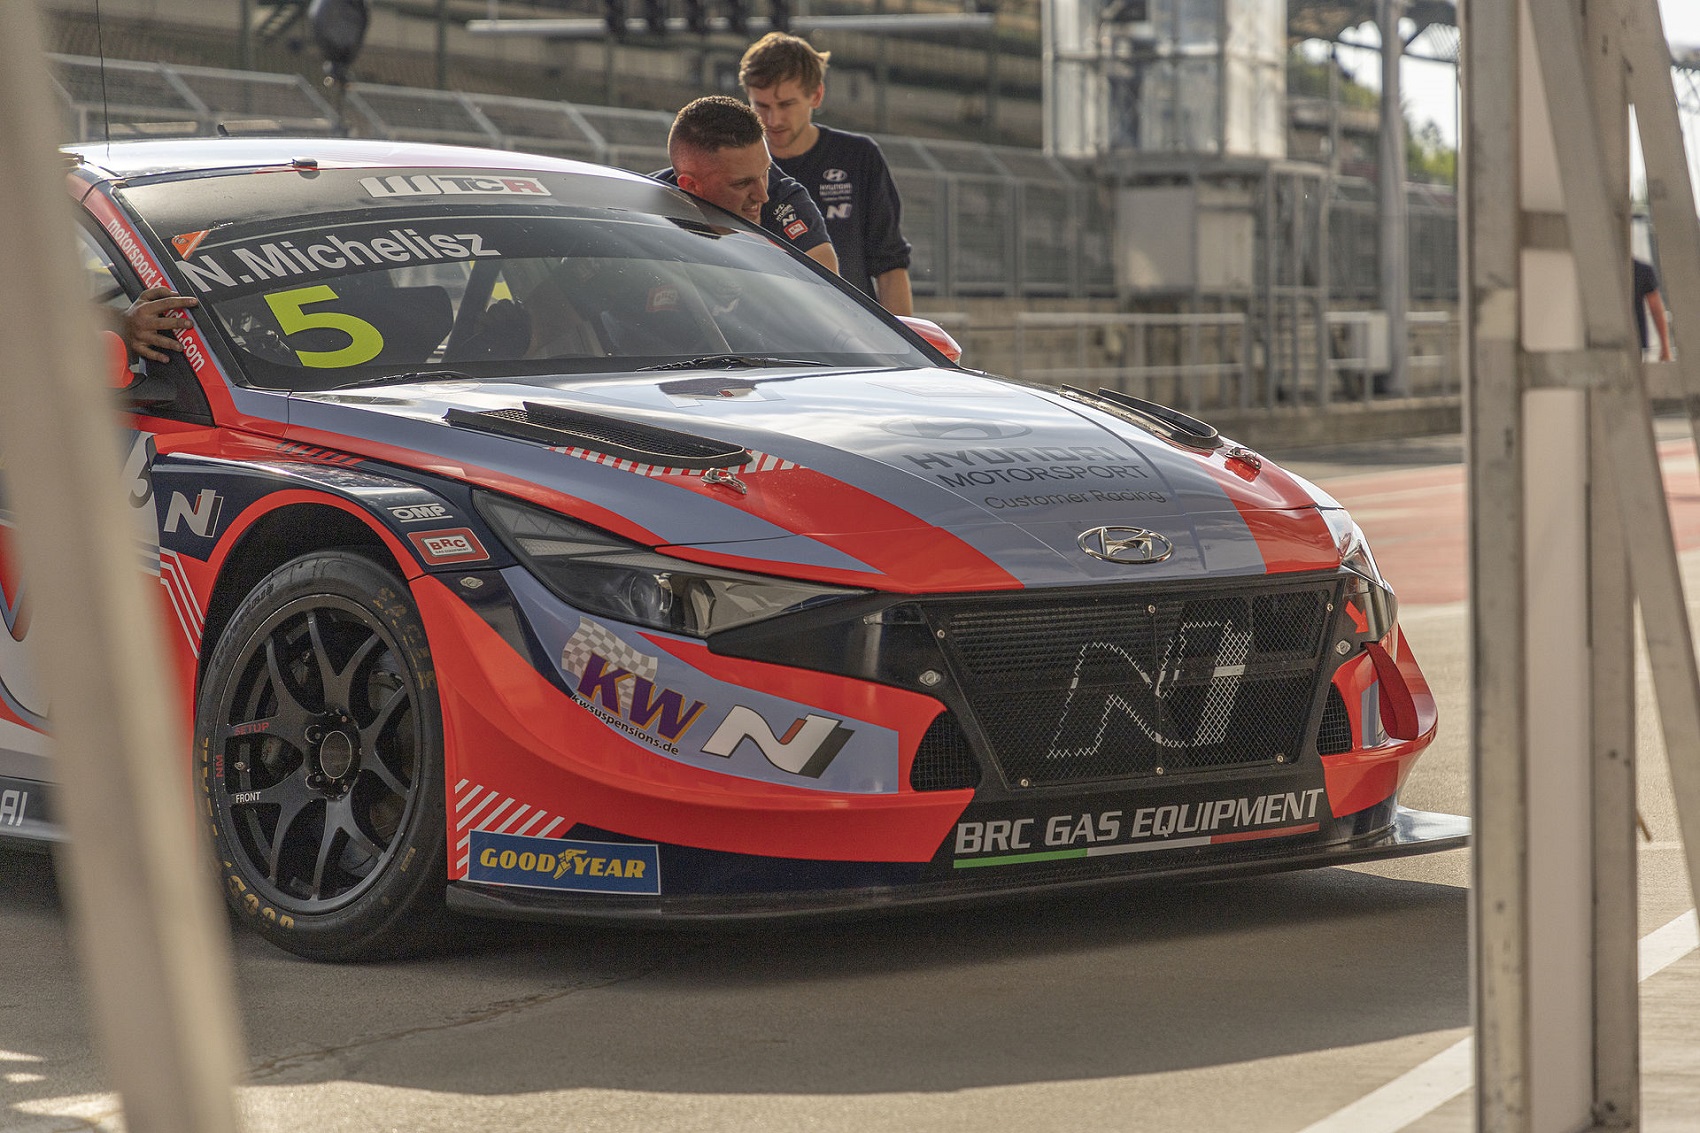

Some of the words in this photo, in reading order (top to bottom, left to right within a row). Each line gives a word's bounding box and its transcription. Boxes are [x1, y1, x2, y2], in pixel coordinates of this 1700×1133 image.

[359, 175, 552, 198] WTCR
[264, 284, 384, 369] 5
[902, 447, 1129, 471] HYUNDAI
[936, 465, 1150, 489] MOTORSPORT
[984, 489, 1091, 511] Customer
[1093, 488, 1167, 504] Racing
[392, 505, 446, 519] OMP
[428, 539, 466, 550] BRC
[577, 652, 708, 744] KW
[234, 722, 270, 736] SETUP
[571, 693, 679, 756] kwsuspensions.de
[235, 791, 261, 803] FRONT
[954, 818, 1034, 855] BRC
[1045, 810, 1122, 847] GAS
[1131, 788, 1324, 837] EQUIPMENT
